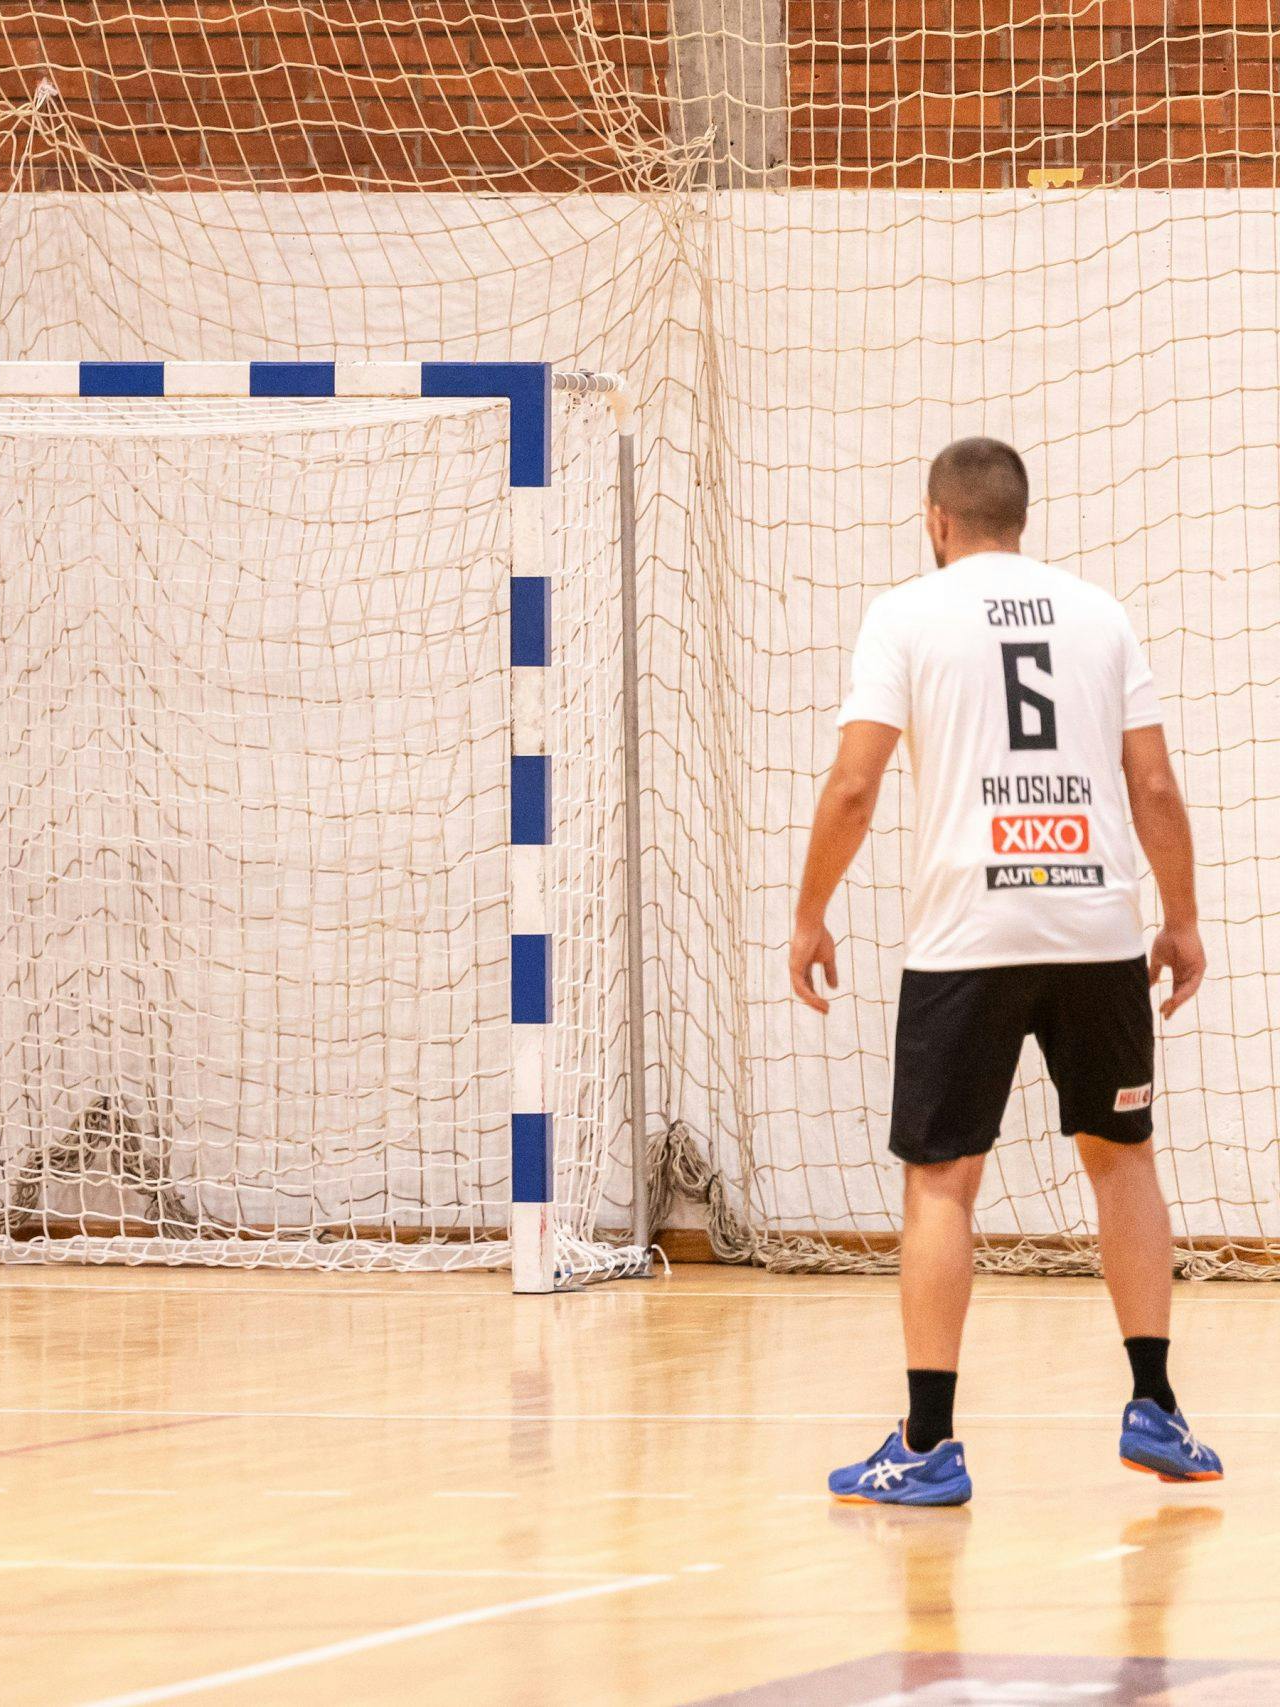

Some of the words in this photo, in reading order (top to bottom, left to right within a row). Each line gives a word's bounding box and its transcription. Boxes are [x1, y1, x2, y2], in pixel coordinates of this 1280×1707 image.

[1000, 642, 1058, 751] 6
[1016, 775, 1093, 806] OSIJEK
[999, 817, 1084, 853] XIXO
[1050, 866, 1099, 885] SMILE
